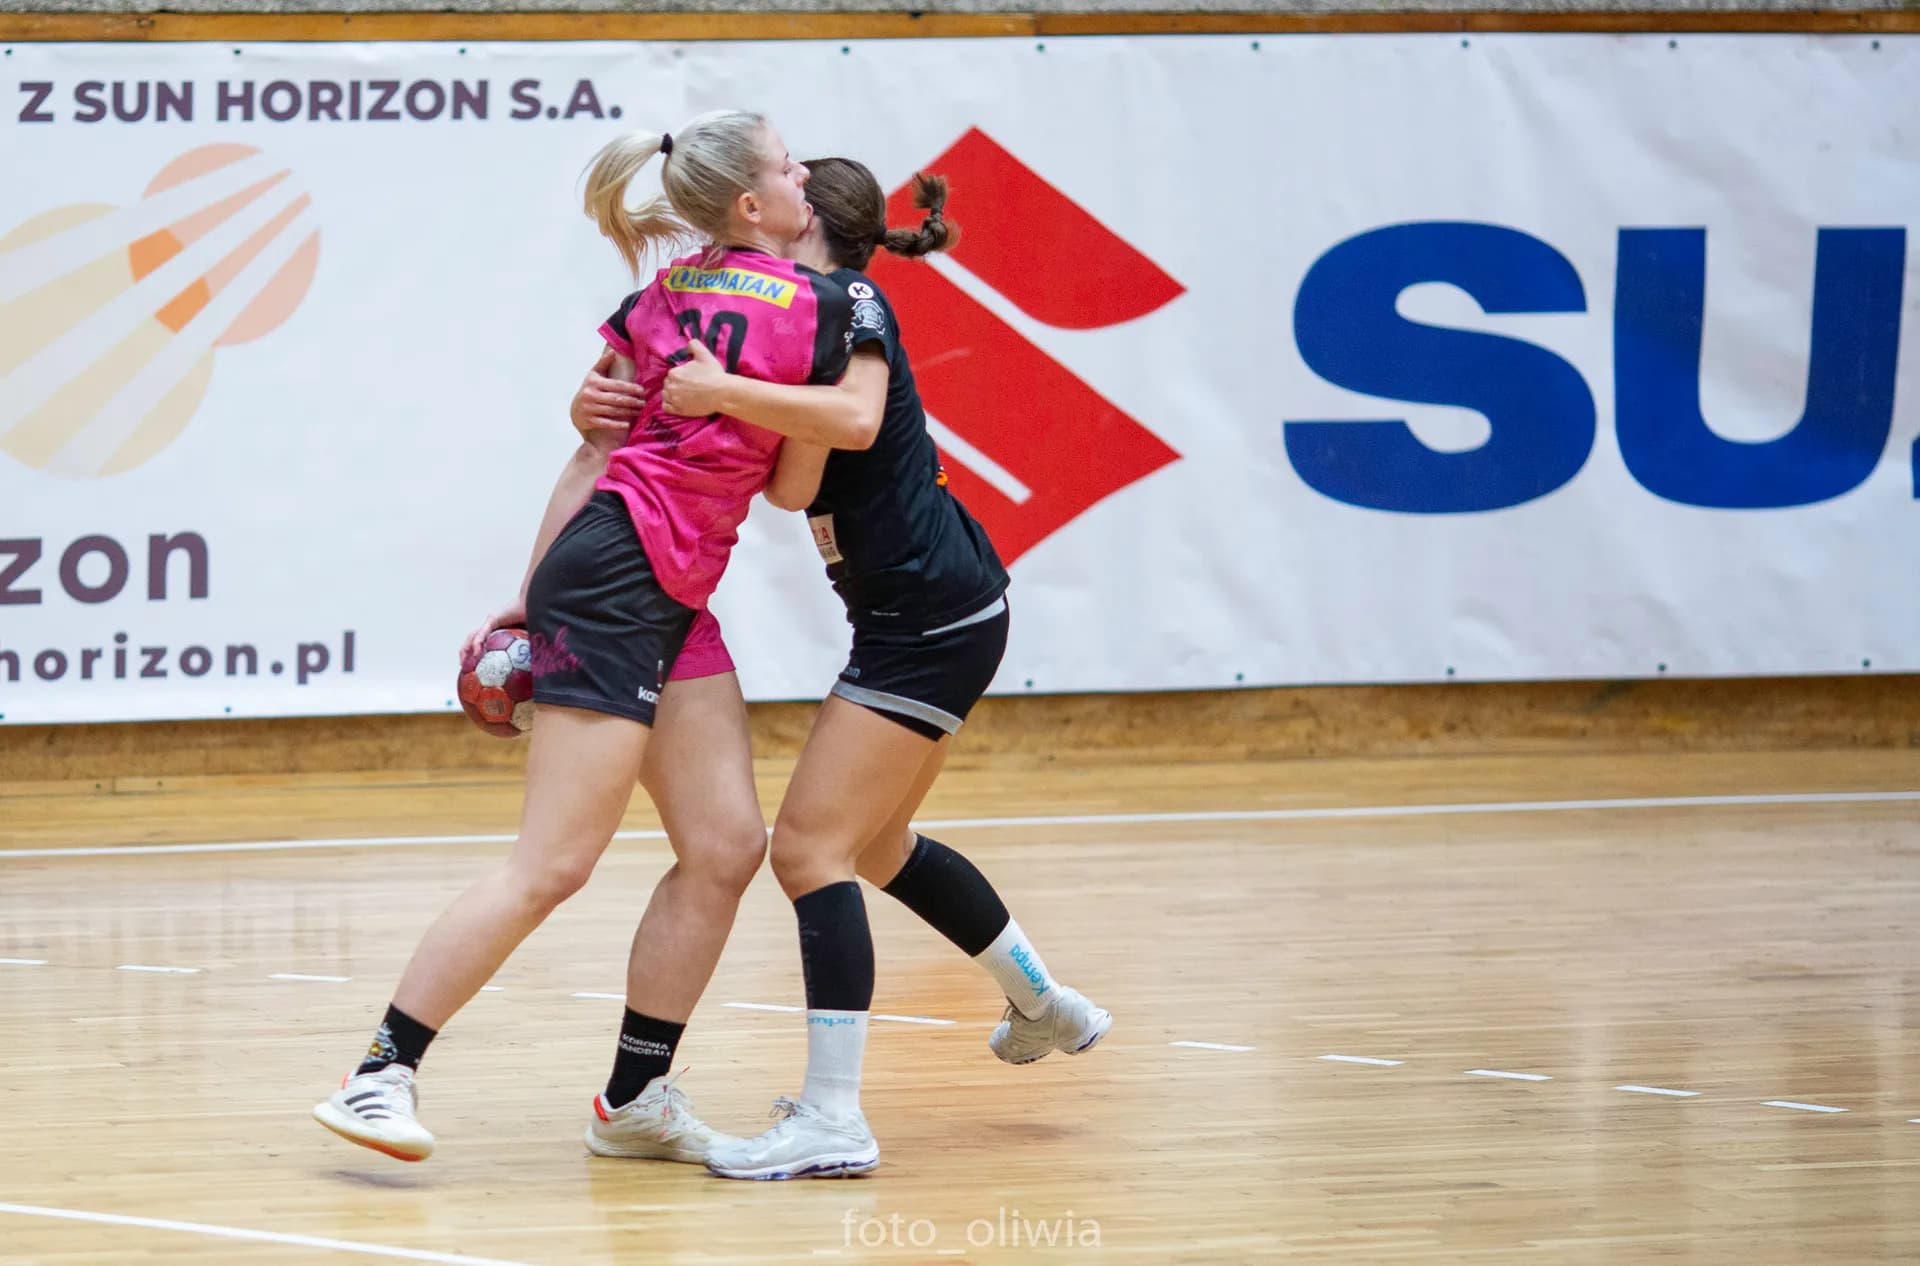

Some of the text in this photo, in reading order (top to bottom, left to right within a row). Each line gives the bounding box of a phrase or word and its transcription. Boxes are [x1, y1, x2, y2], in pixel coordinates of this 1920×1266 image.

[18, 79, 622, 123] Z SUN HORIZON S.A.
[1282, 220, 1920, 515] SU
[622, 1033, 670, 1051] KORONA
